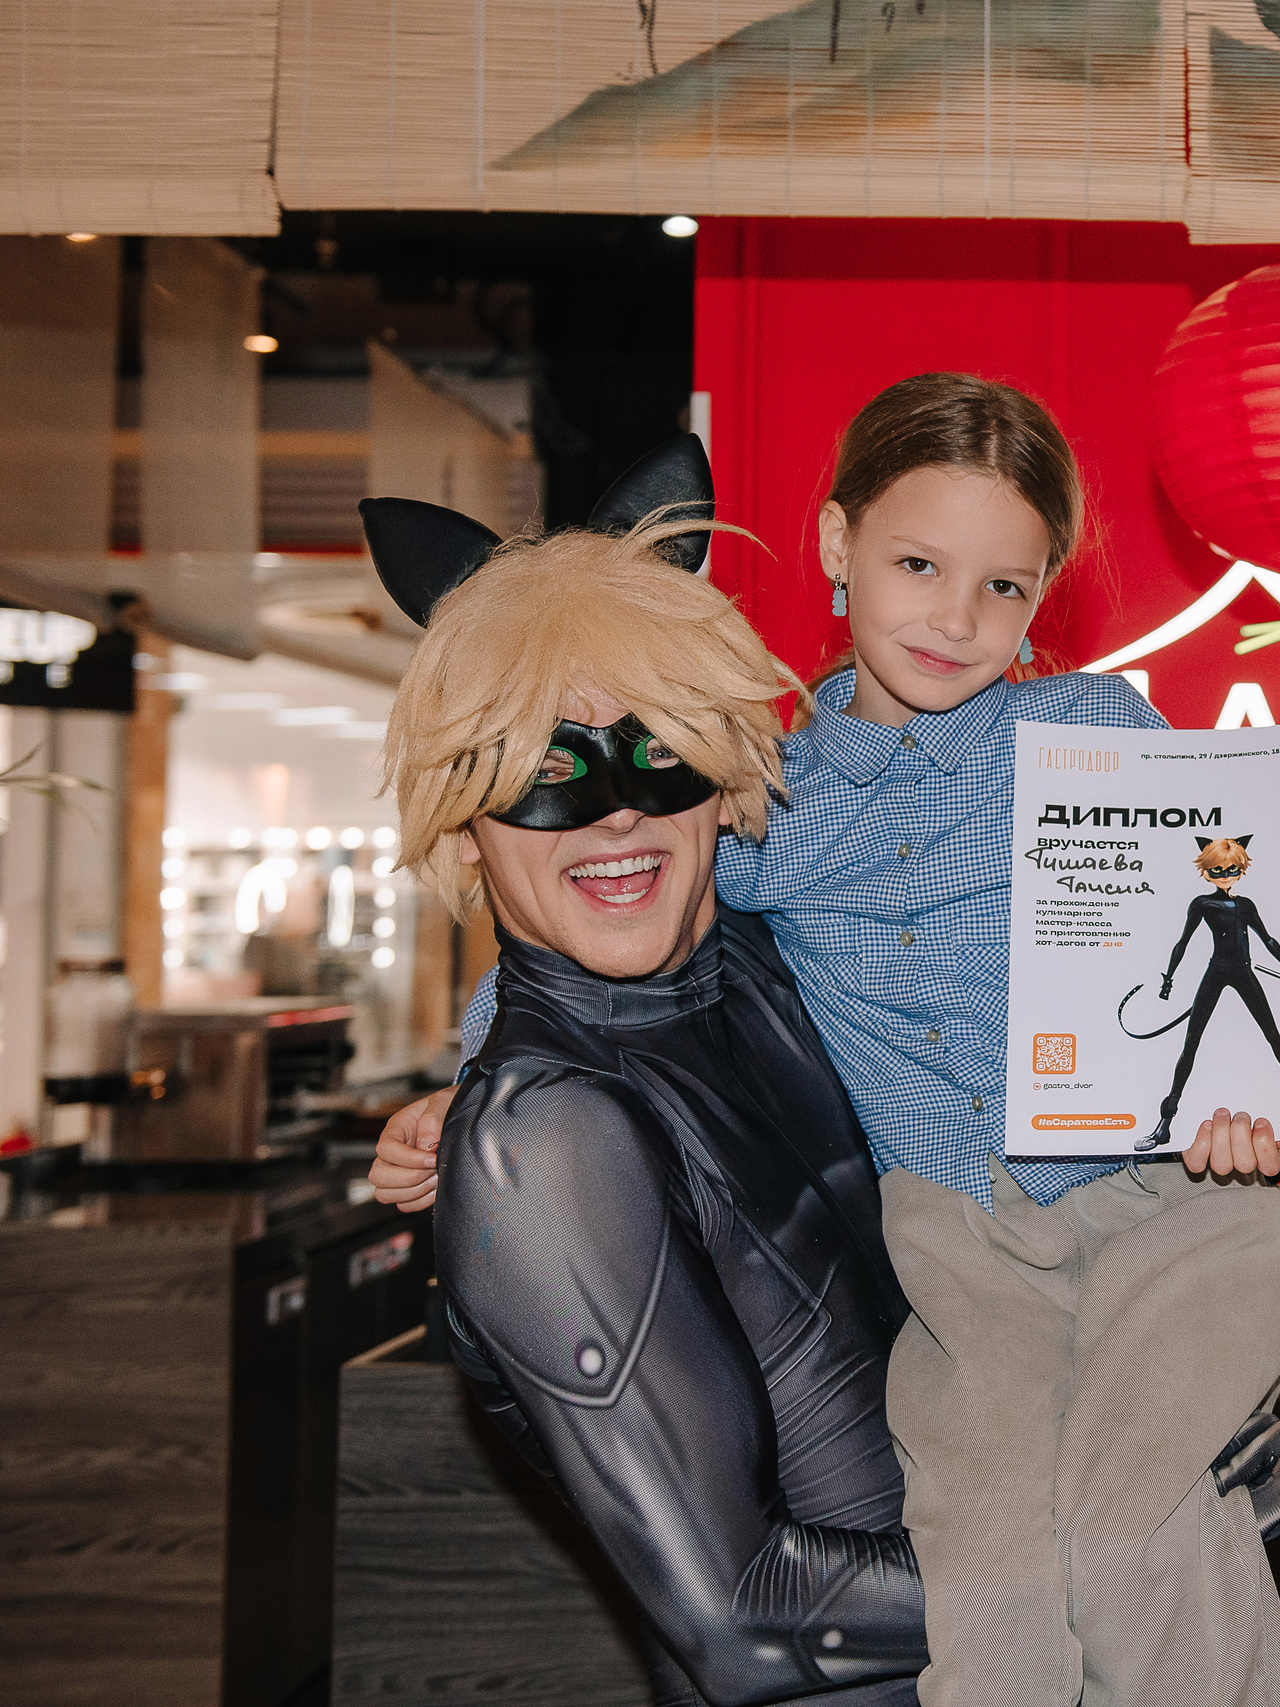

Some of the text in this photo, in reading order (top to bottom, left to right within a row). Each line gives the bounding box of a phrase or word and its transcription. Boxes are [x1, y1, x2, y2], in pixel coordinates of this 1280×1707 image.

[1038, 746, 1120, 773] ГАСТРОДВОР
[1141, 752, 1153, 761] пр.
[1154, 753, 1198, 761] столыпина,
[1214, 750, 1271, 760] дзержинского,
[1037, 803, 1222, 829] ДИПЛОМ
[1037, 837, 1139, 850] вручается
[1050, 900, 1120, 908] прохождение
[1035, 909, 1103, 918] кулинарного
[1035, 919, 1113, 928] мастер-класса
[1050, 930, 1131, 938] приготовлению
[1043, 1082, 1094, 1090] gastro_dvor
[1038, 1117, 1131, 1127] #вСаратовеЕсть
